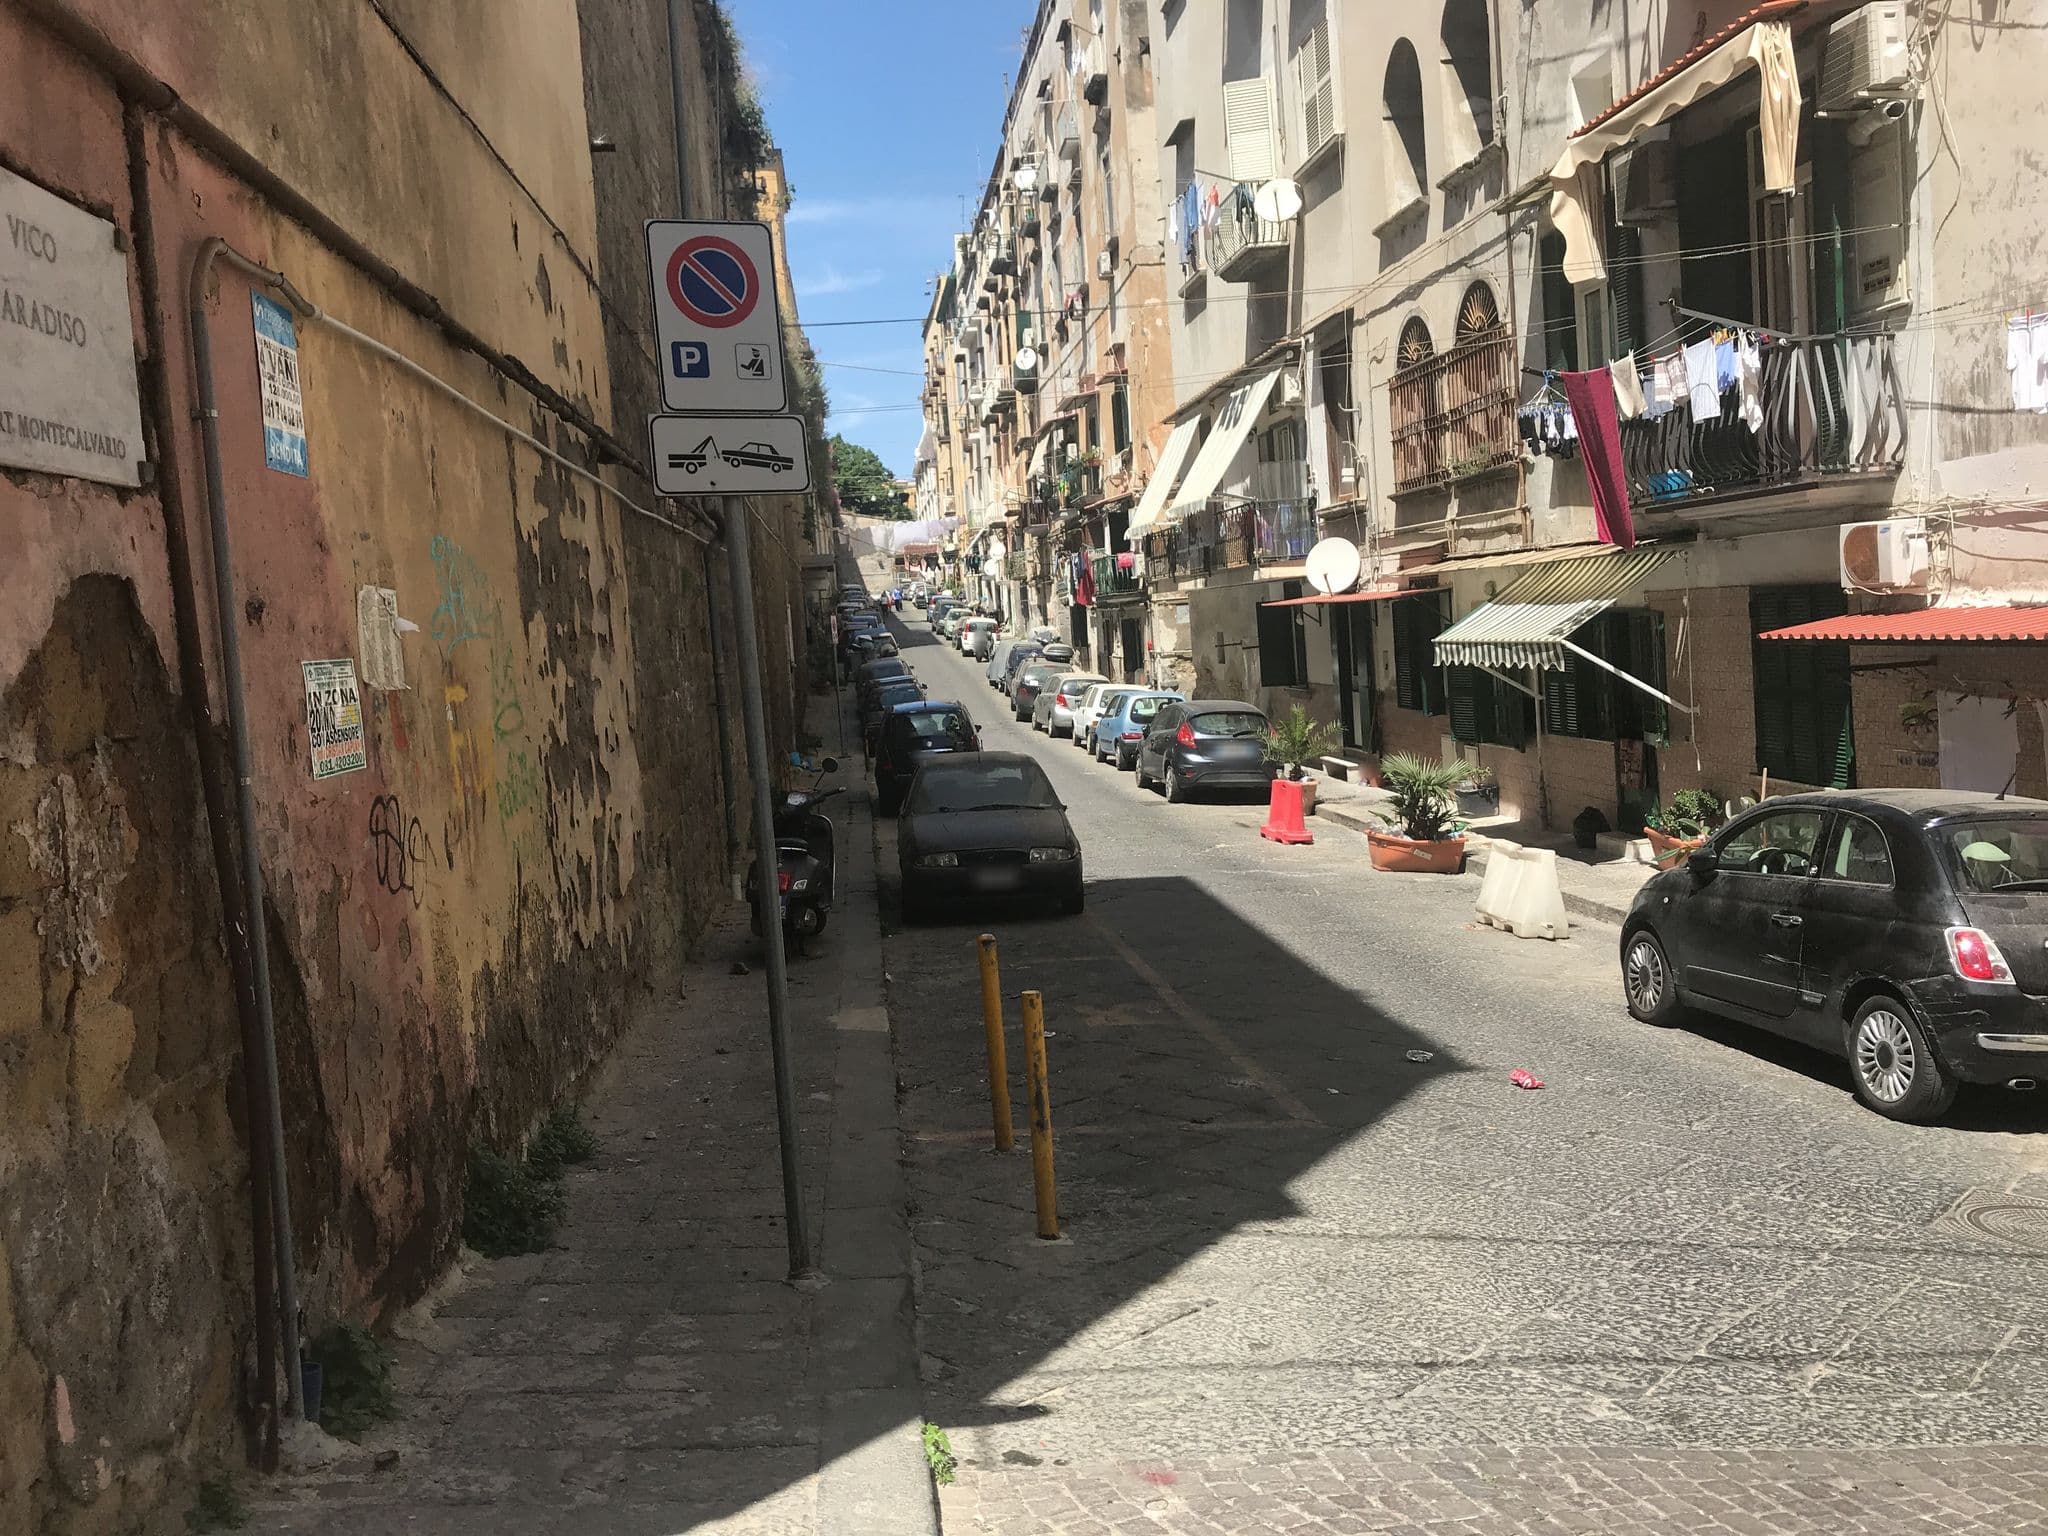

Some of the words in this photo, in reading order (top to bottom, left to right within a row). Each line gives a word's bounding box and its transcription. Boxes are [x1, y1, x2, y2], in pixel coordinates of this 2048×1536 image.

[7, 213, 57, 264] VICO
[267, 350, 298, 384] VANI
[680, 346, 701, 374] P
[18, 413, 126, 460] MONTECALVARIO
[307, 690, 322, 709] IN
[325, 687, 357, 706] ZONA
[311, 731, 325, 749] CO
[326, 725, 360, 746] ASCENSORE
